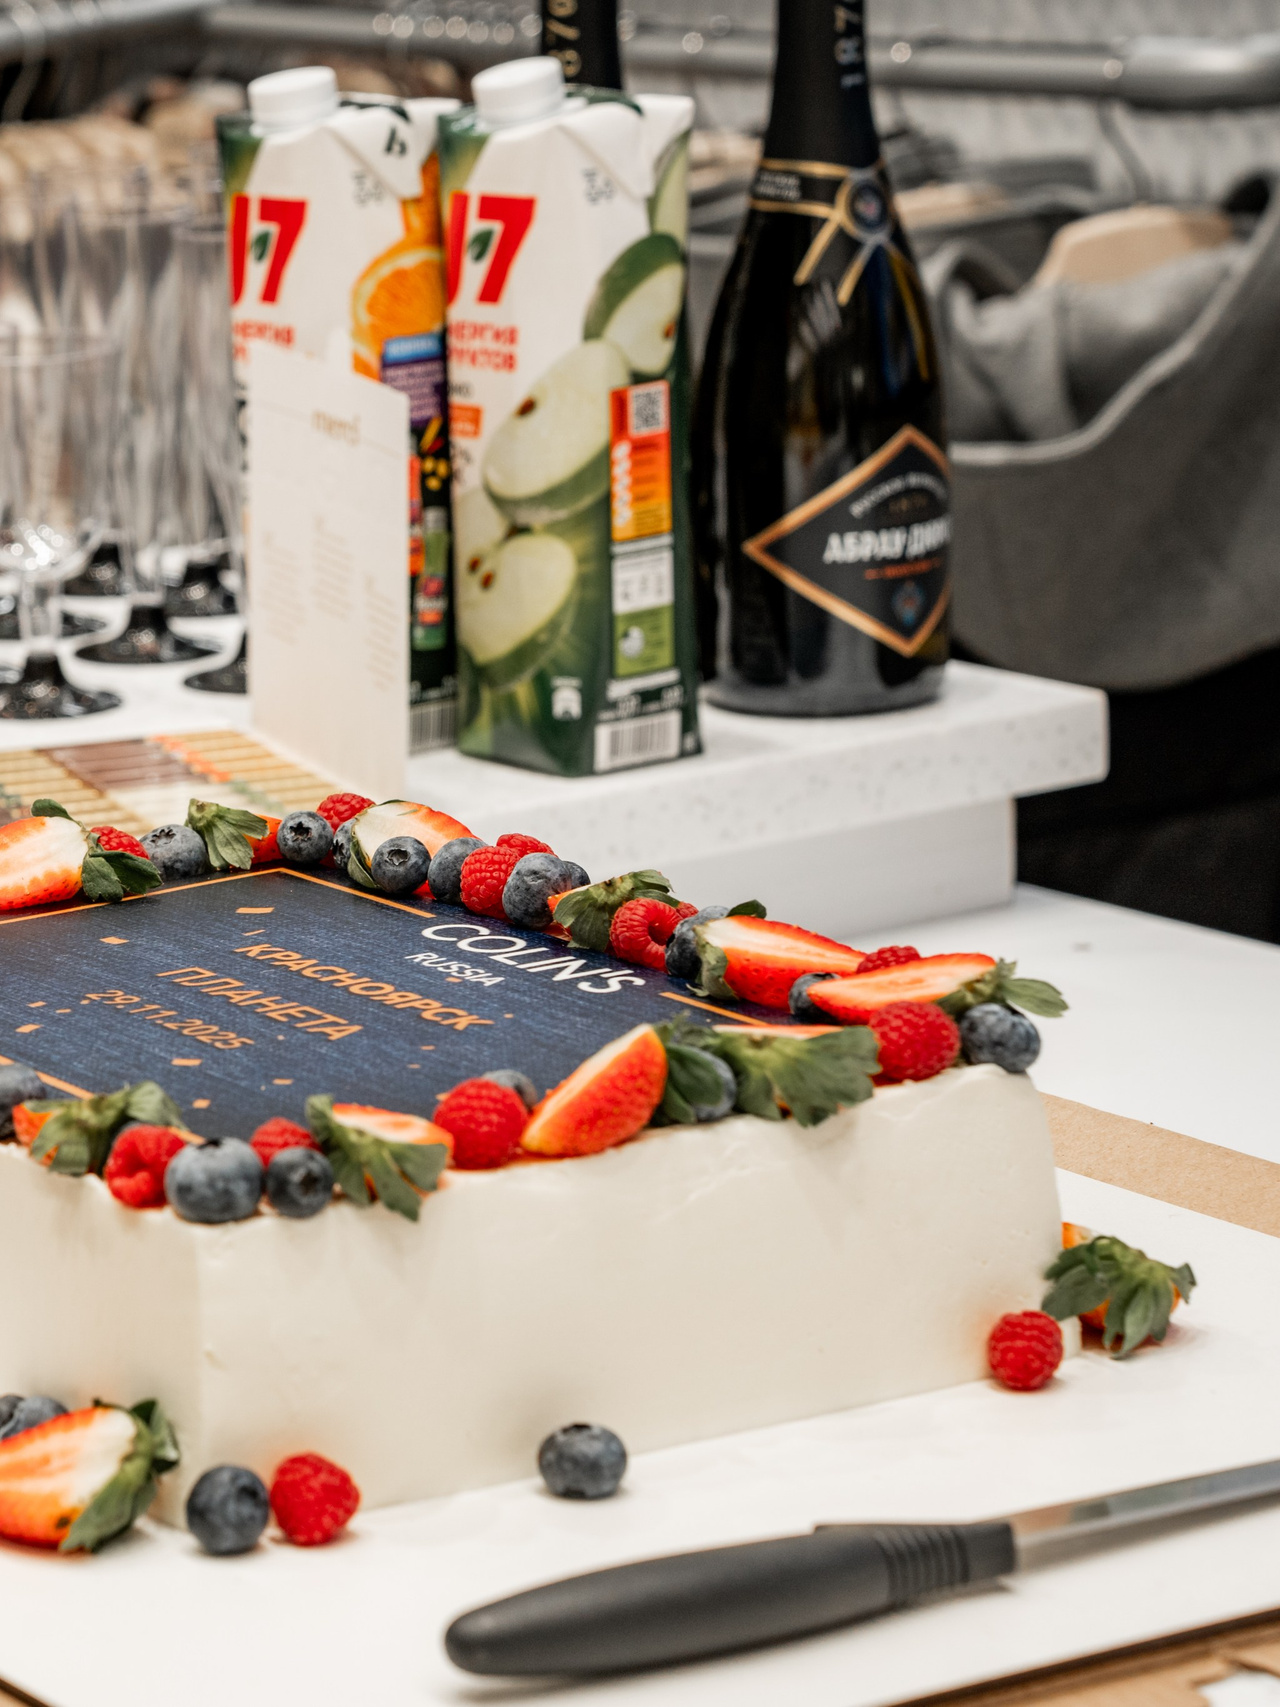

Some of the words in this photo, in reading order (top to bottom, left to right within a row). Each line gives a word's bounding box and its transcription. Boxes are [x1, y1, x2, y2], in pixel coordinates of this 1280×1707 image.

[234, 943, 495, 1031] КРАСНОЯРСК
[404, 951, 505, 987] RUSSIA
[421, 923, 647, 994] COLIN'S
[85, 989, 255, 1049] 29.11.2025
[156, 966, 364, 1041] ПЛАНЕТА
